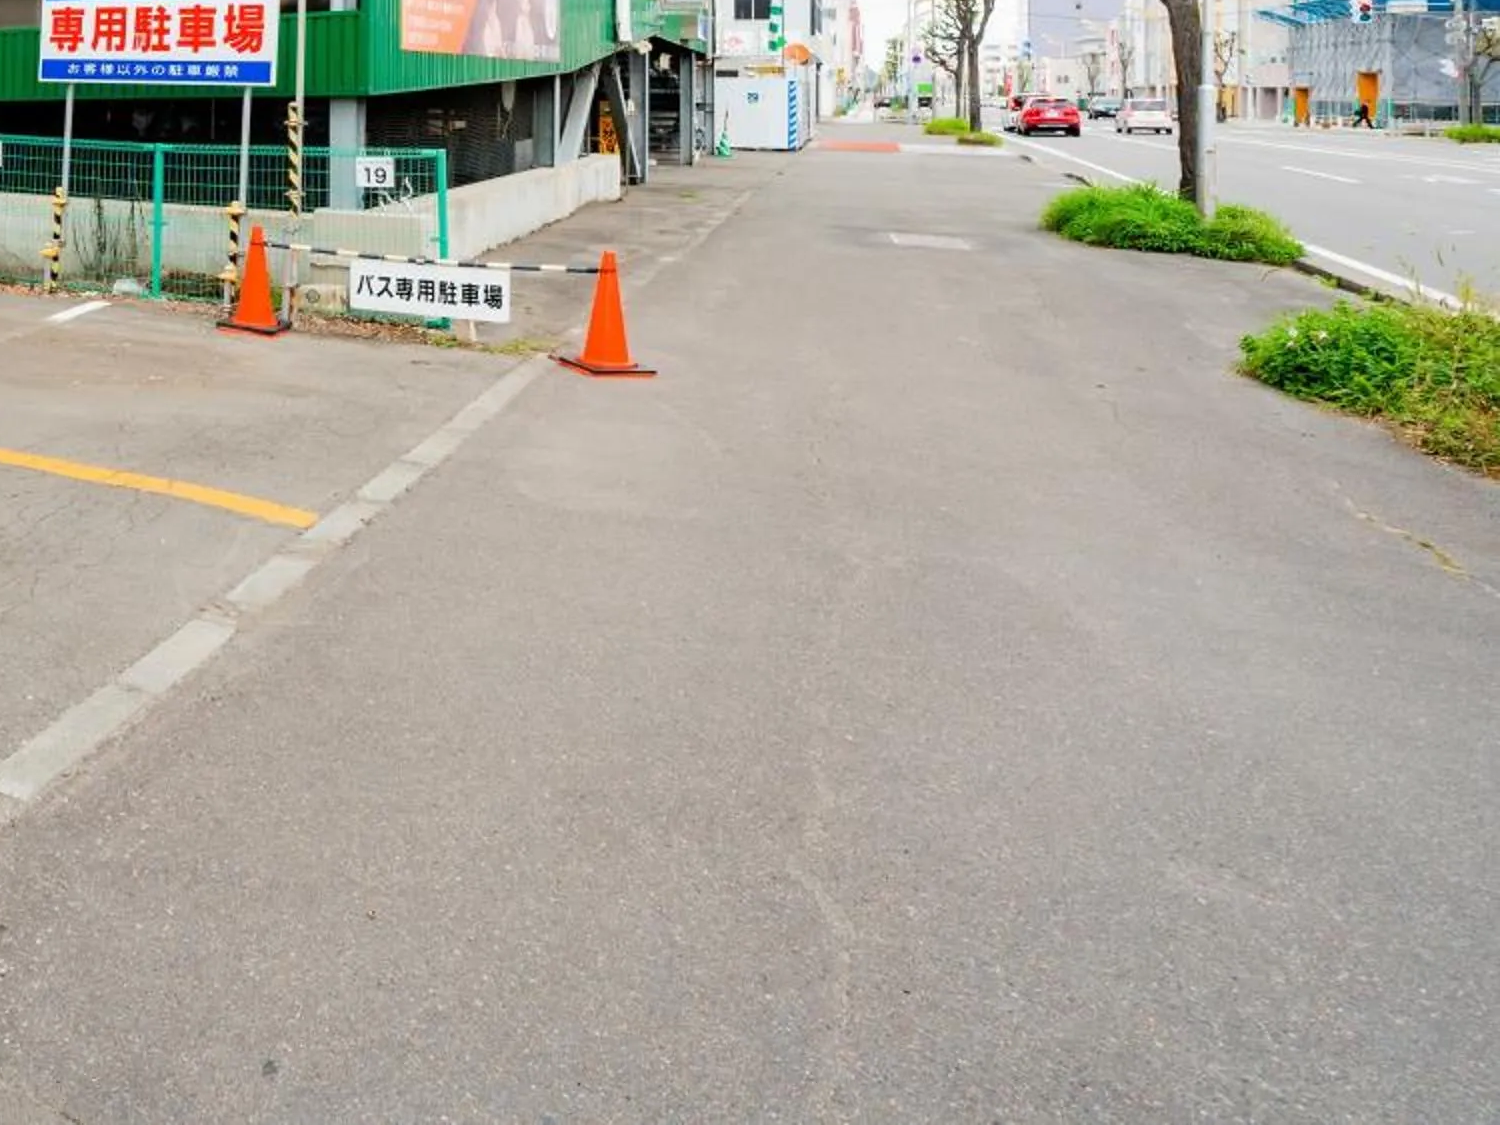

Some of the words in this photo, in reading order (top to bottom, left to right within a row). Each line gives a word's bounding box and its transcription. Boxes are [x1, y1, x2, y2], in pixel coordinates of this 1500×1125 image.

[49, 3, 265, 54] 専用駐車場
[363, 167, 387, 184] 19
[356, 275, 504, 310] バス専用駐車場
